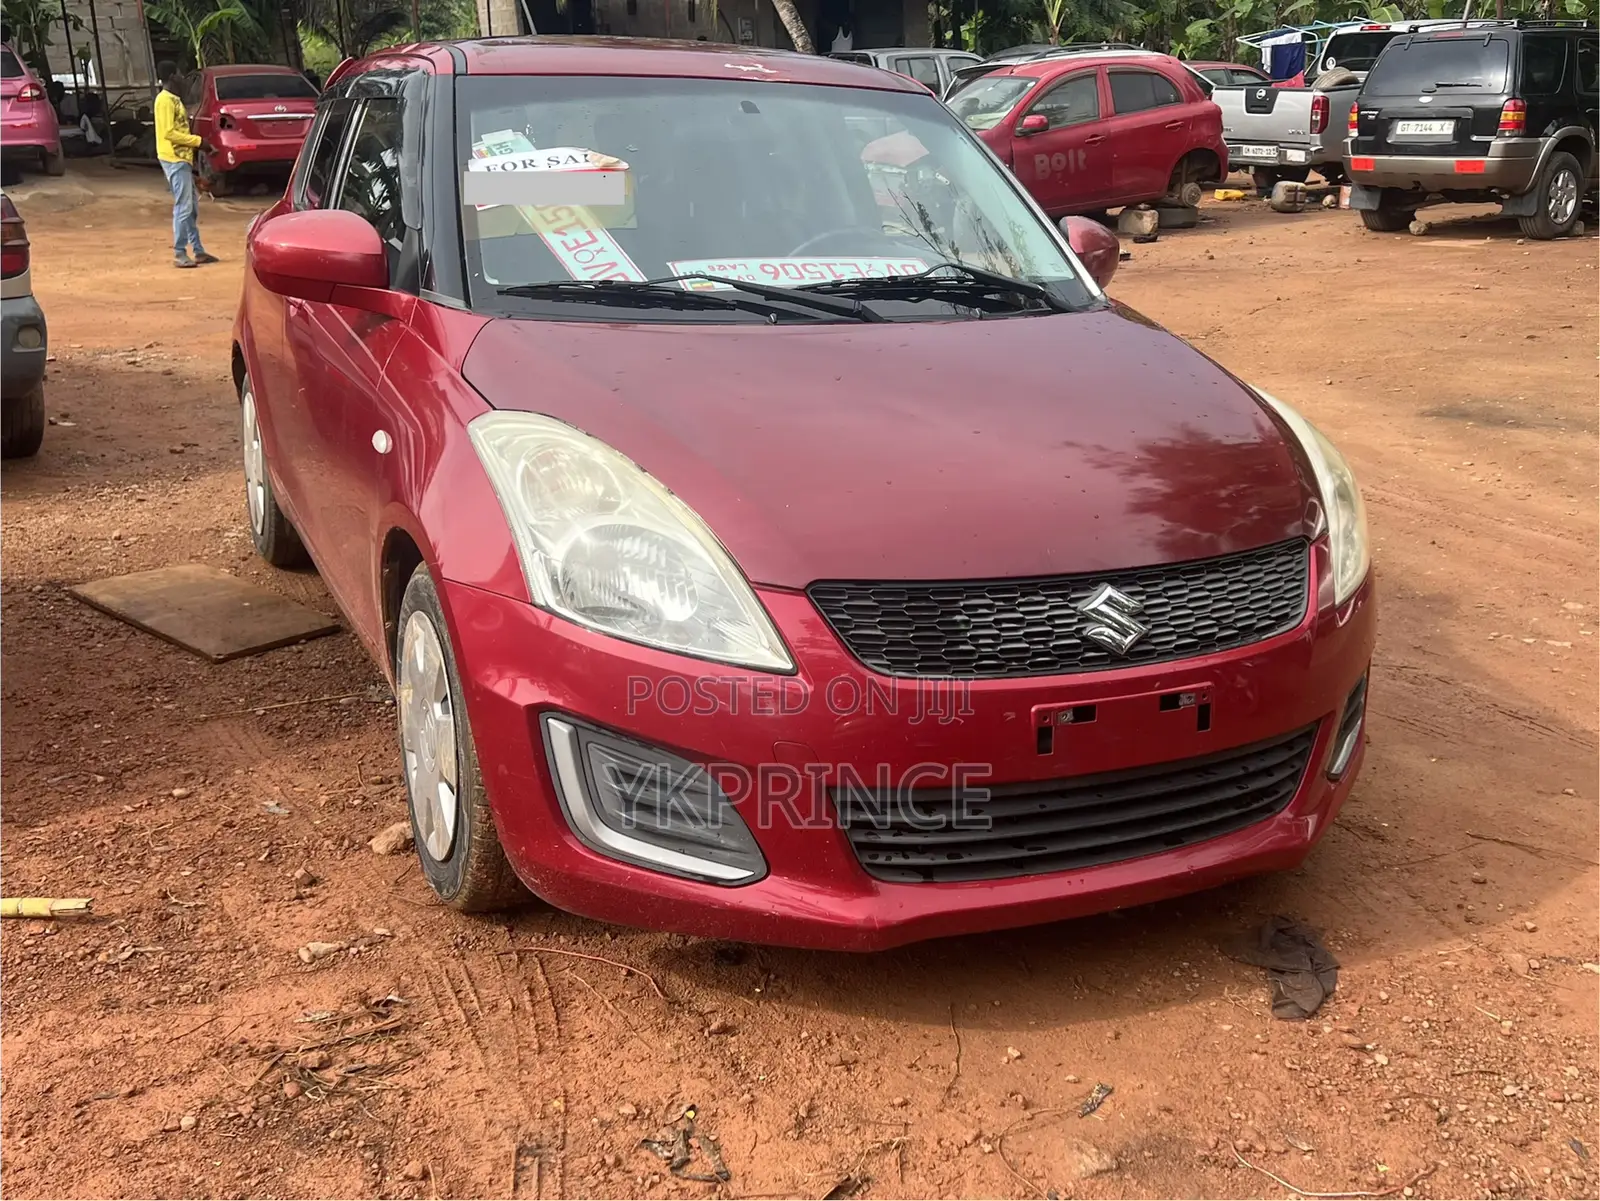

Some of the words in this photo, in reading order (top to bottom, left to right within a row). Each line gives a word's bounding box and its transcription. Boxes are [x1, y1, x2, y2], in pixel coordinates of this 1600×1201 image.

[485, 158, 540, 172] FOR
[546, 153, 591, 166] SAL
[1034, 148, 1087, 180] Bolt
